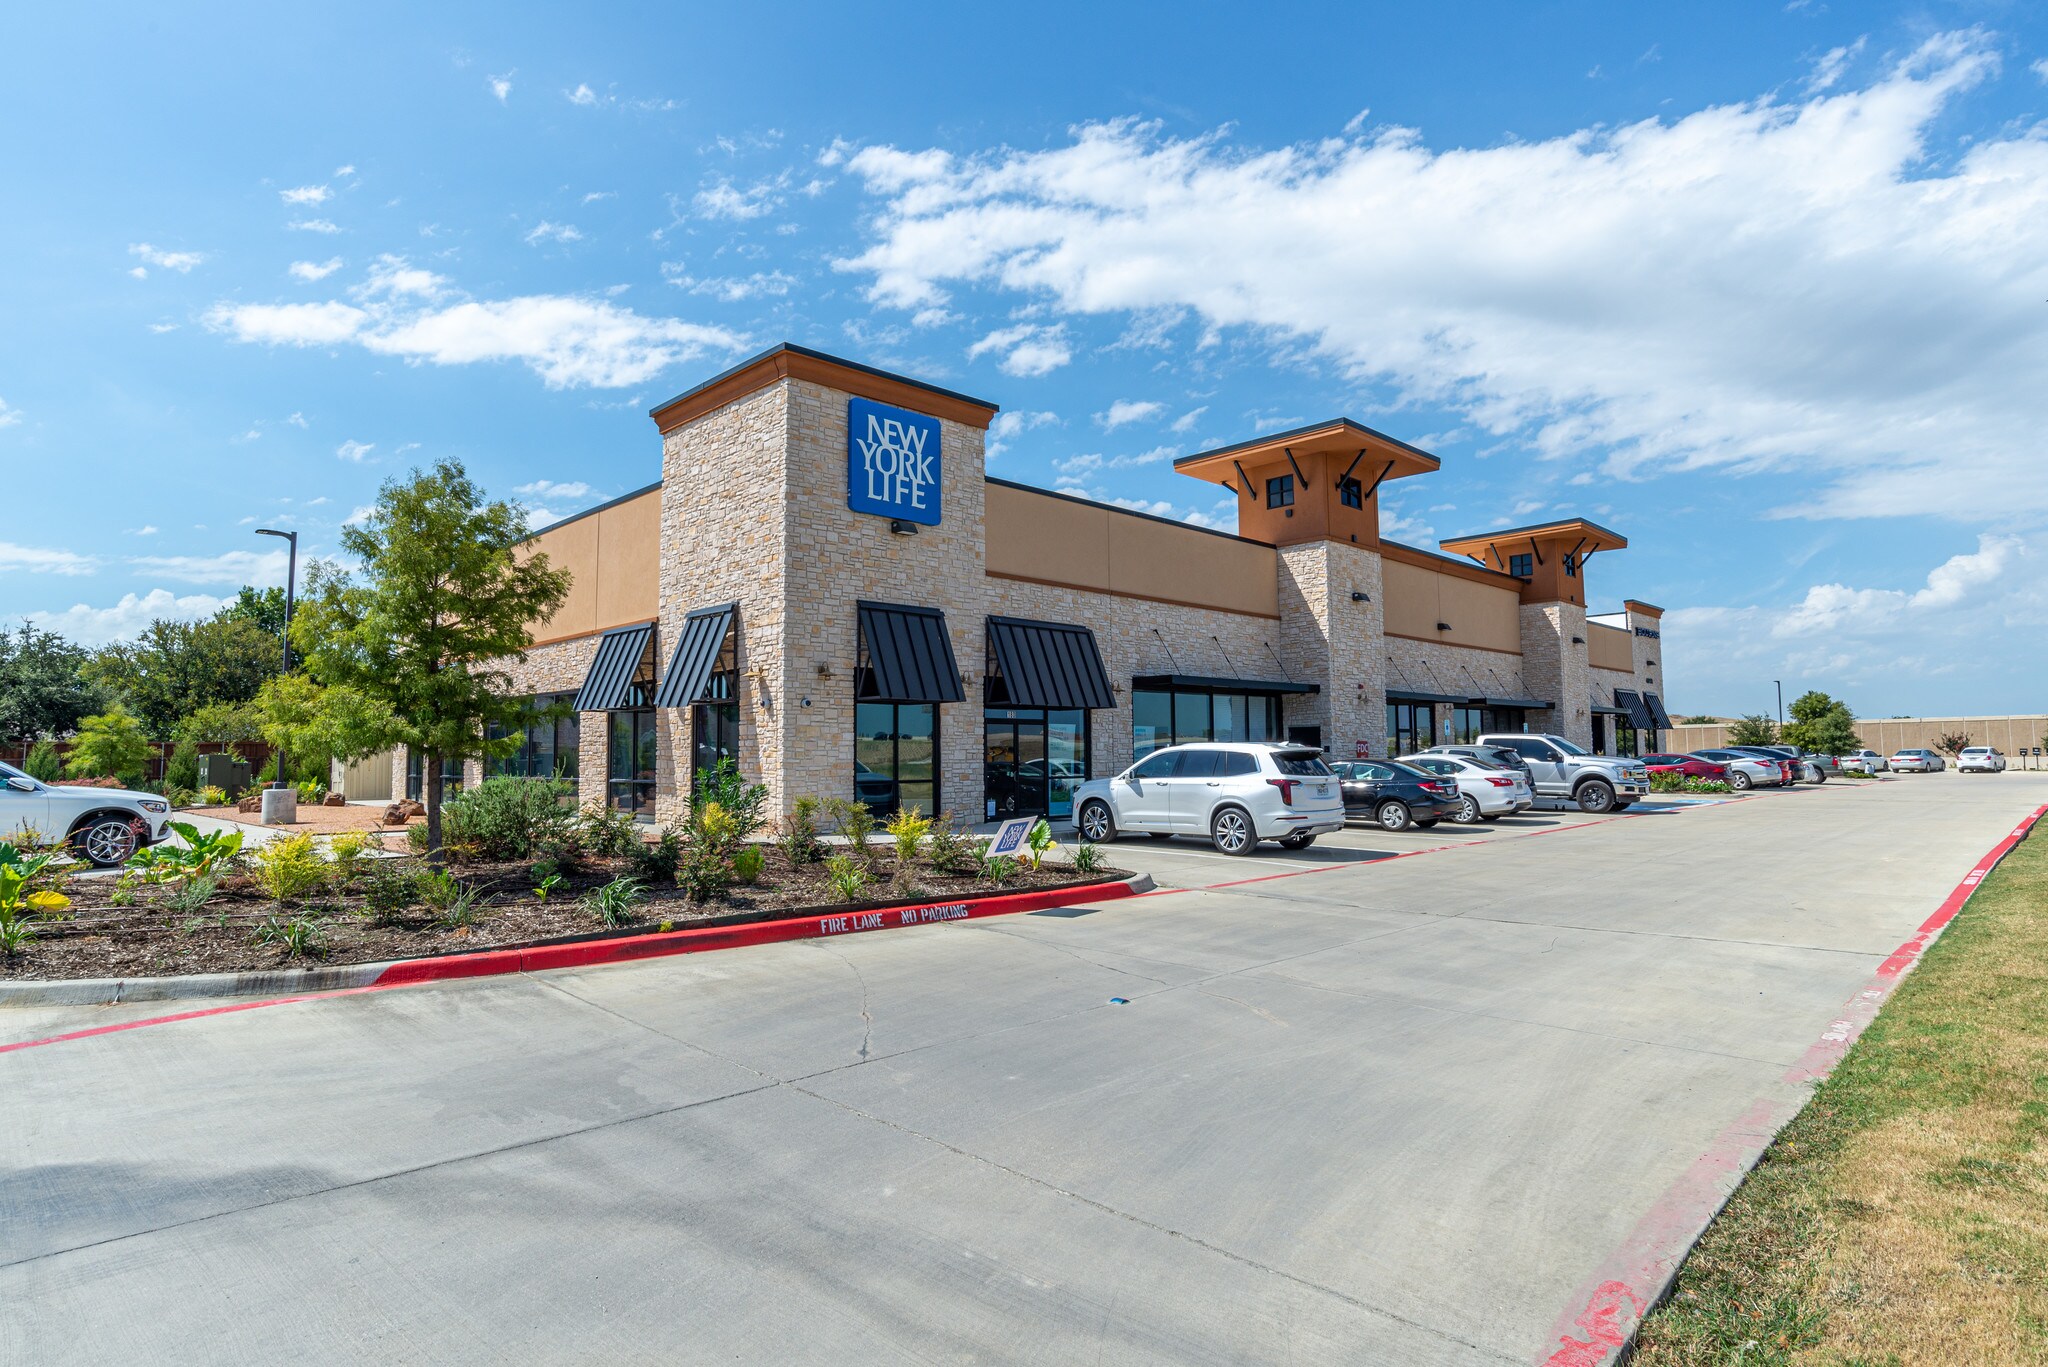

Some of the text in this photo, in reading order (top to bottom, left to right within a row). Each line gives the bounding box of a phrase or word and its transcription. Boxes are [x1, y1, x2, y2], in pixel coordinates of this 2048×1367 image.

[867, 414, 928, 453] NEW
[856, 438, 935, 485] YORK
[867, 468, 926, 509] LIFE
[1357, 743, 1368, 753] FDC
[1000, 840, 1016, 849] LIFE
[820, 904, 968, 934] FIRE LANE NO PARKING
